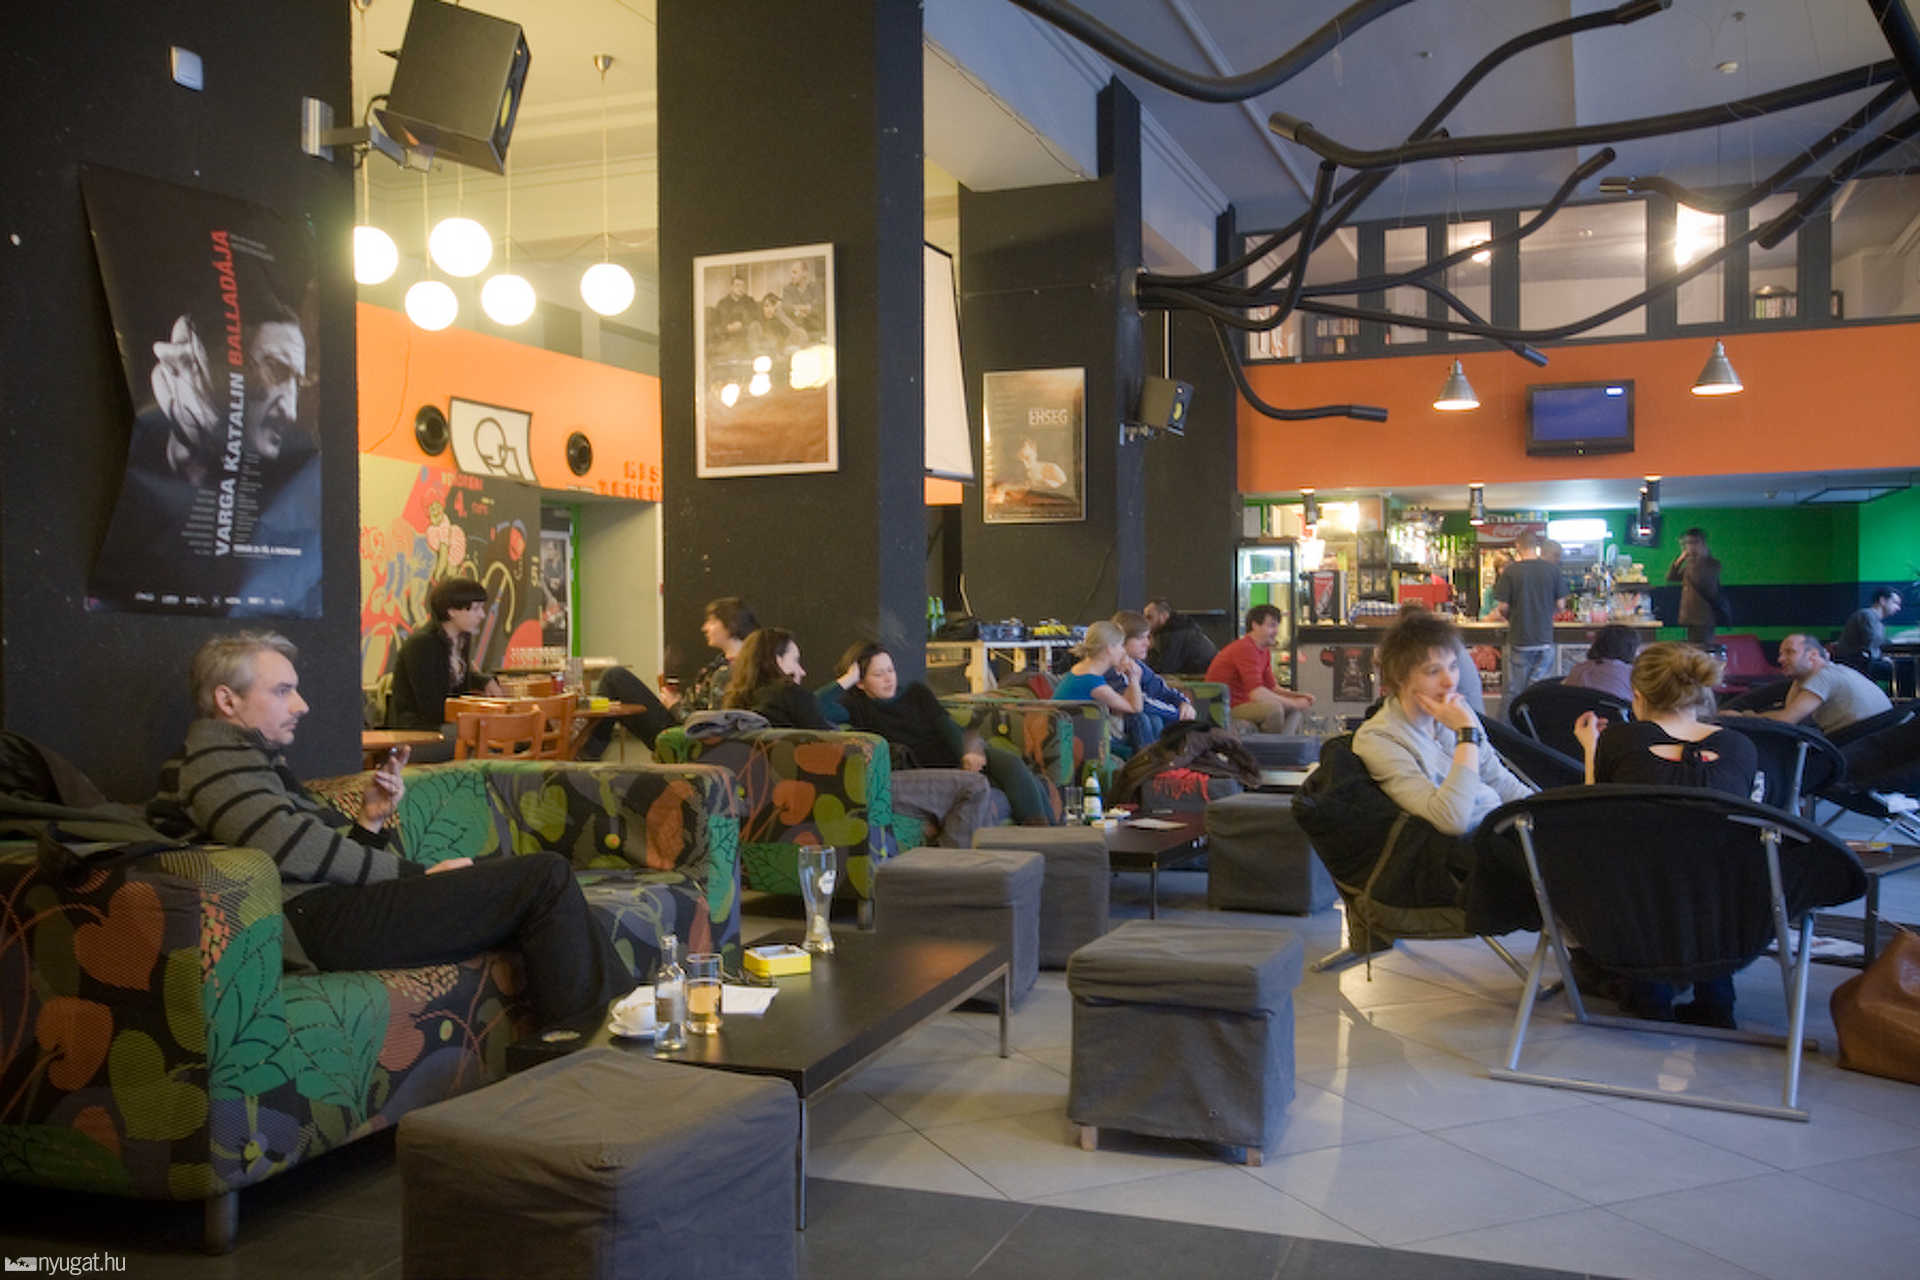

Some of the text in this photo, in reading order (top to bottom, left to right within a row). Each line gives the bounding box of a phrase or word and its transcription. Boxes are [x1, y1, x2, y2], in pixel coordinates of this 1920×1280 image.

[210, 230, 245, 557] VARGA KATALIN BALLADÁJA
